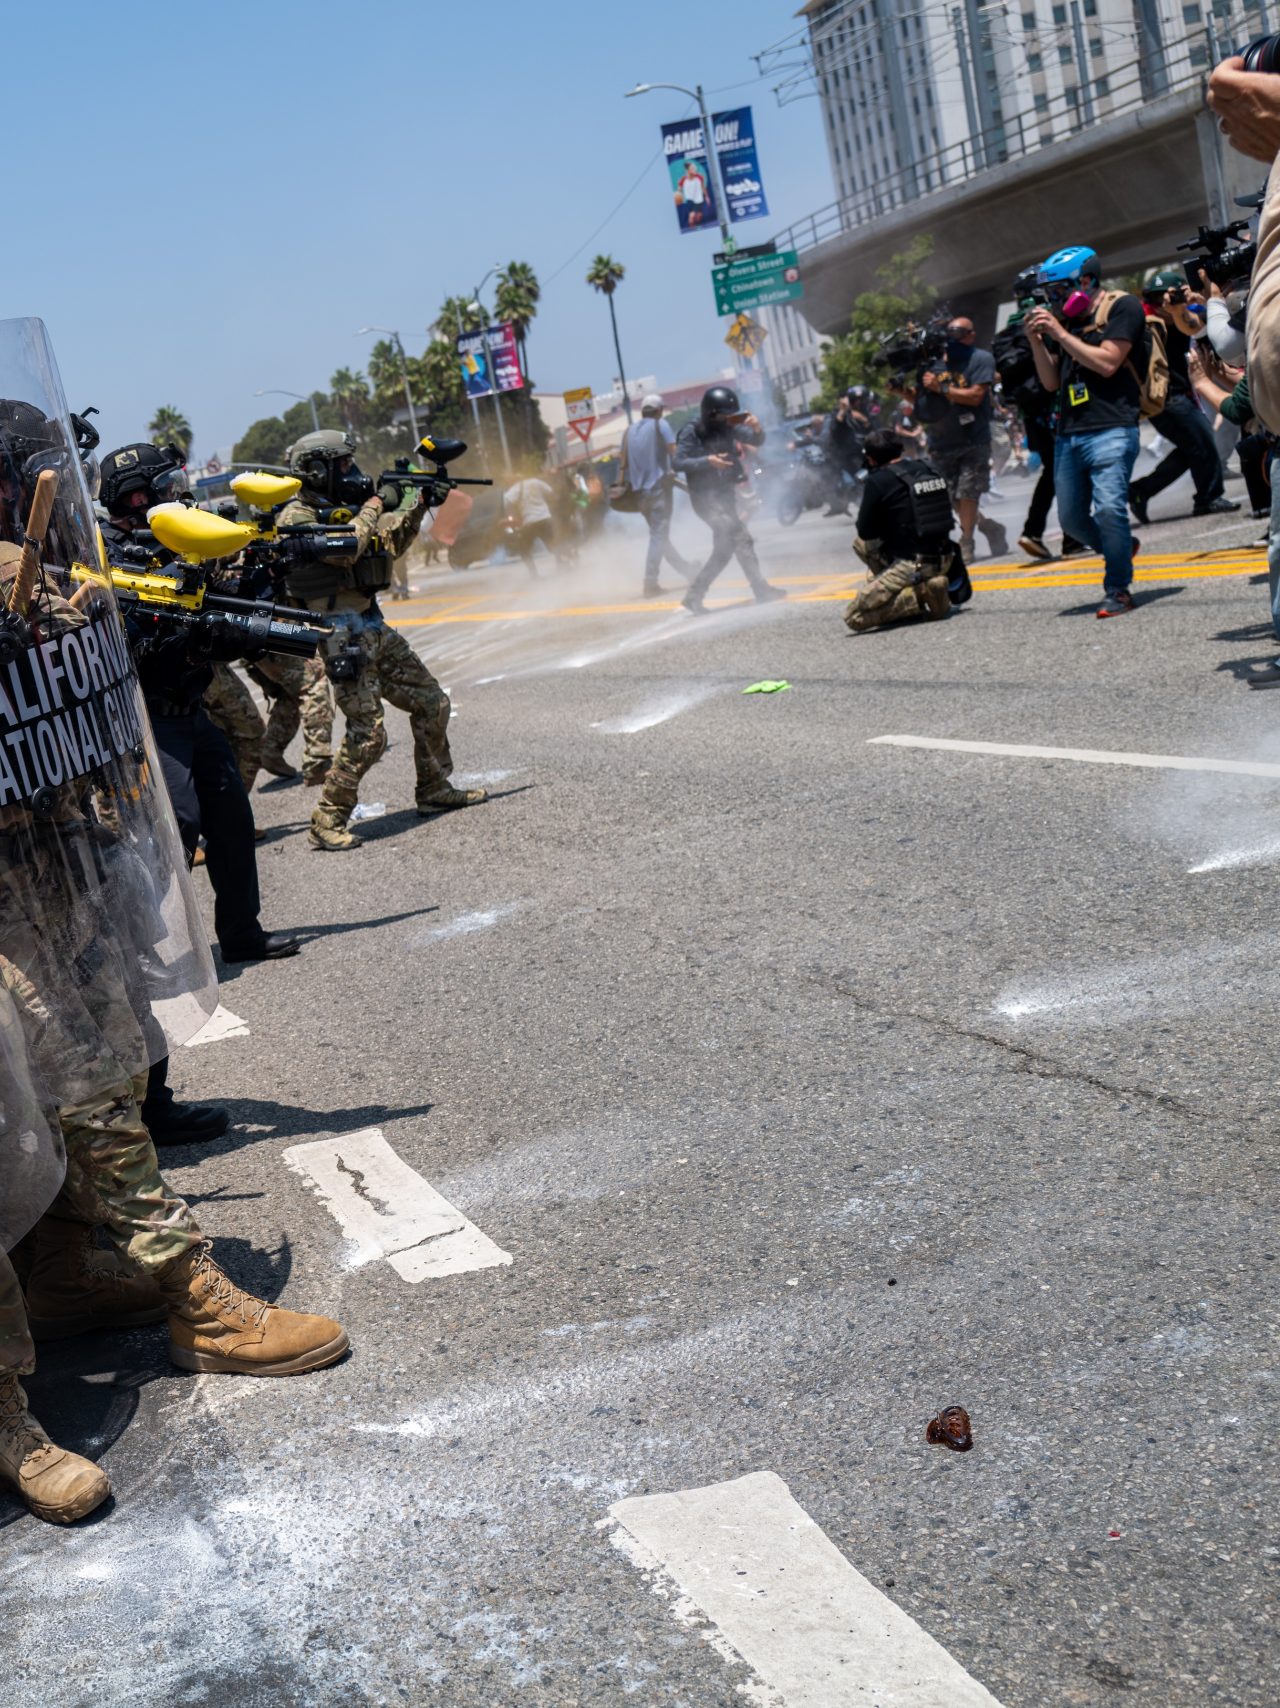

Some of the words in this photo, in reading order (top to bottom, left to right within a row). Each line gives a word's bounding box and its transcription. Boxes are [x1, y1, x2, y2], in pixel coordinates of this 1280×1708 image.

[664, 128, 704, 155] GAME
[757, 256, 784, 271] Street
[731, 277, 775, 294] Chinatown
[759, 289, 790, 302] Station
[914, 477, 947, 495] PRESS
